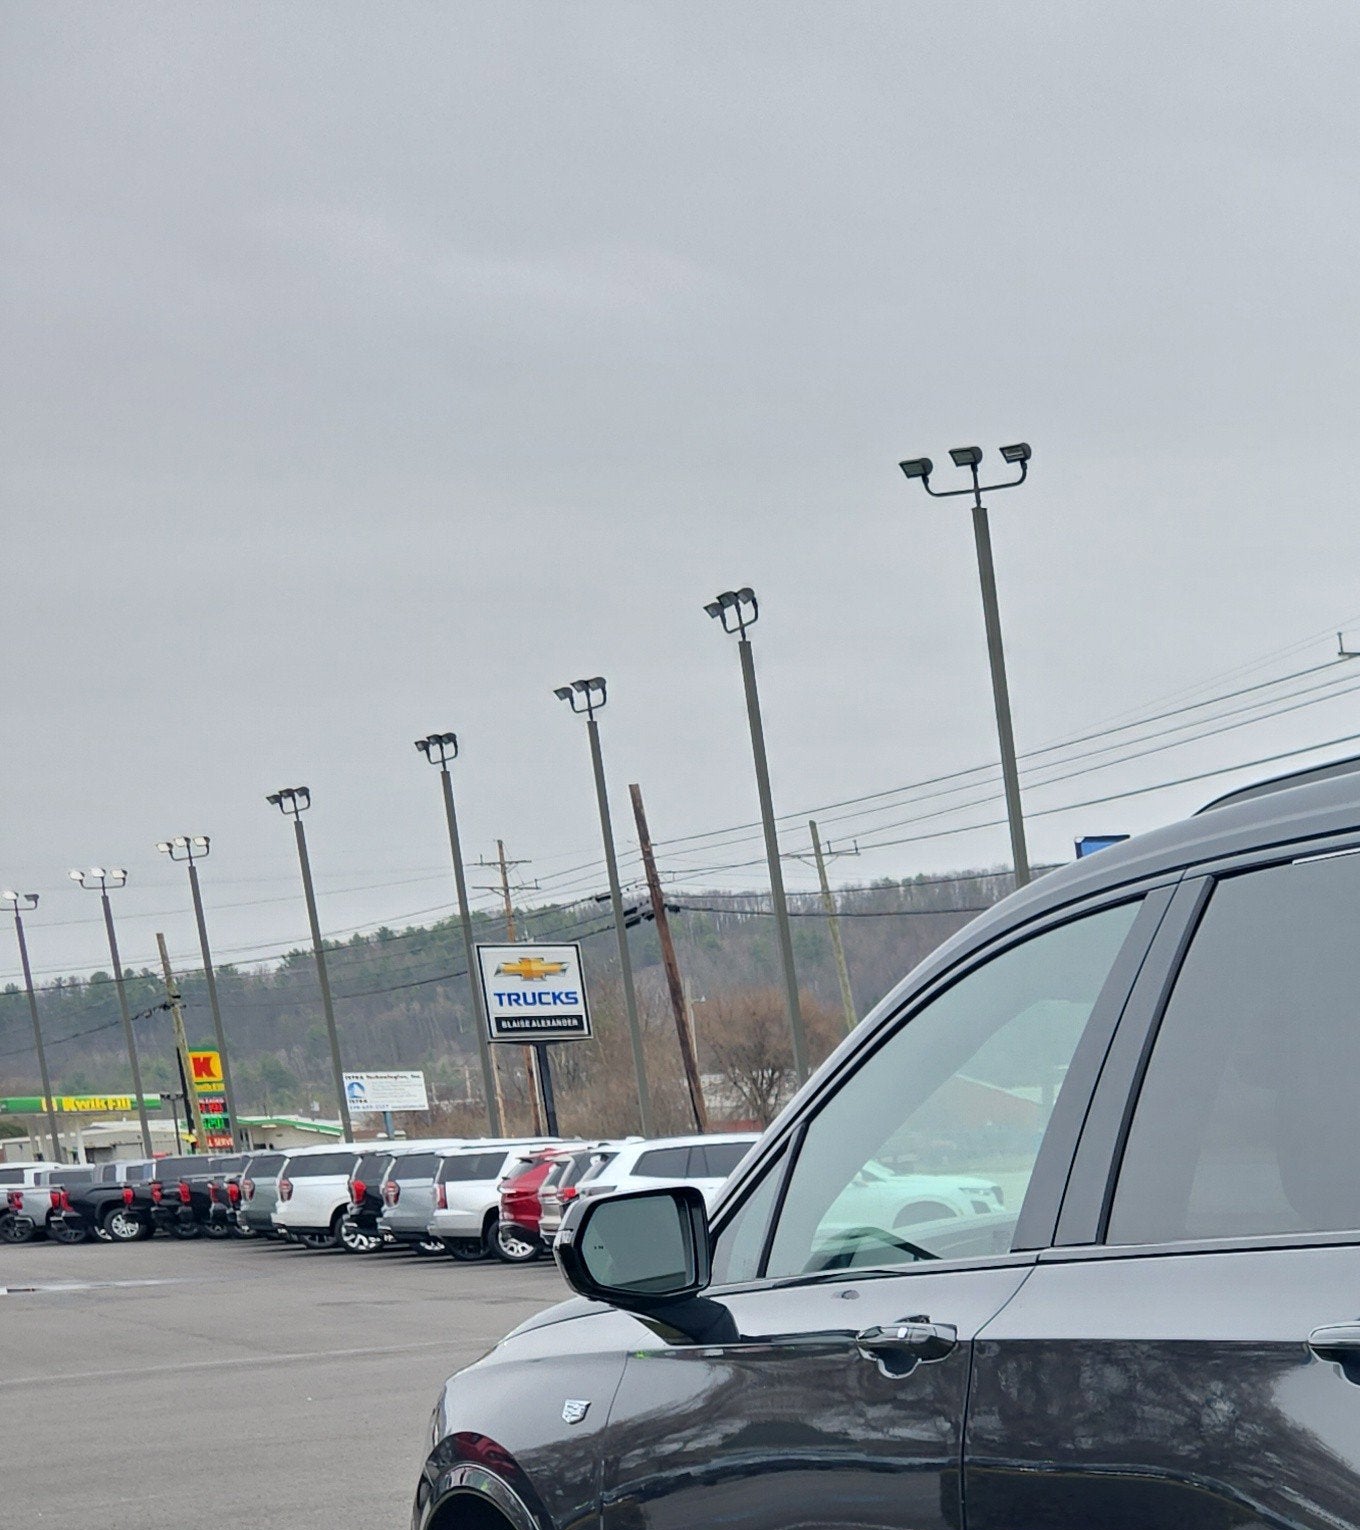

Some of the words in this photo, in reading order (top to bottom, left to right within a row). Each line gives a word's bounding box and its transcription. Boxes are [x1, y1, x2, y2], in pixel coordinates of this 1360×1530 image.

[493, 991, 579, 1006] TRUCKS
[501, 1019, 531, 1029] BLAISE
[531, 1017, 579, 1028] ALEXANDER
